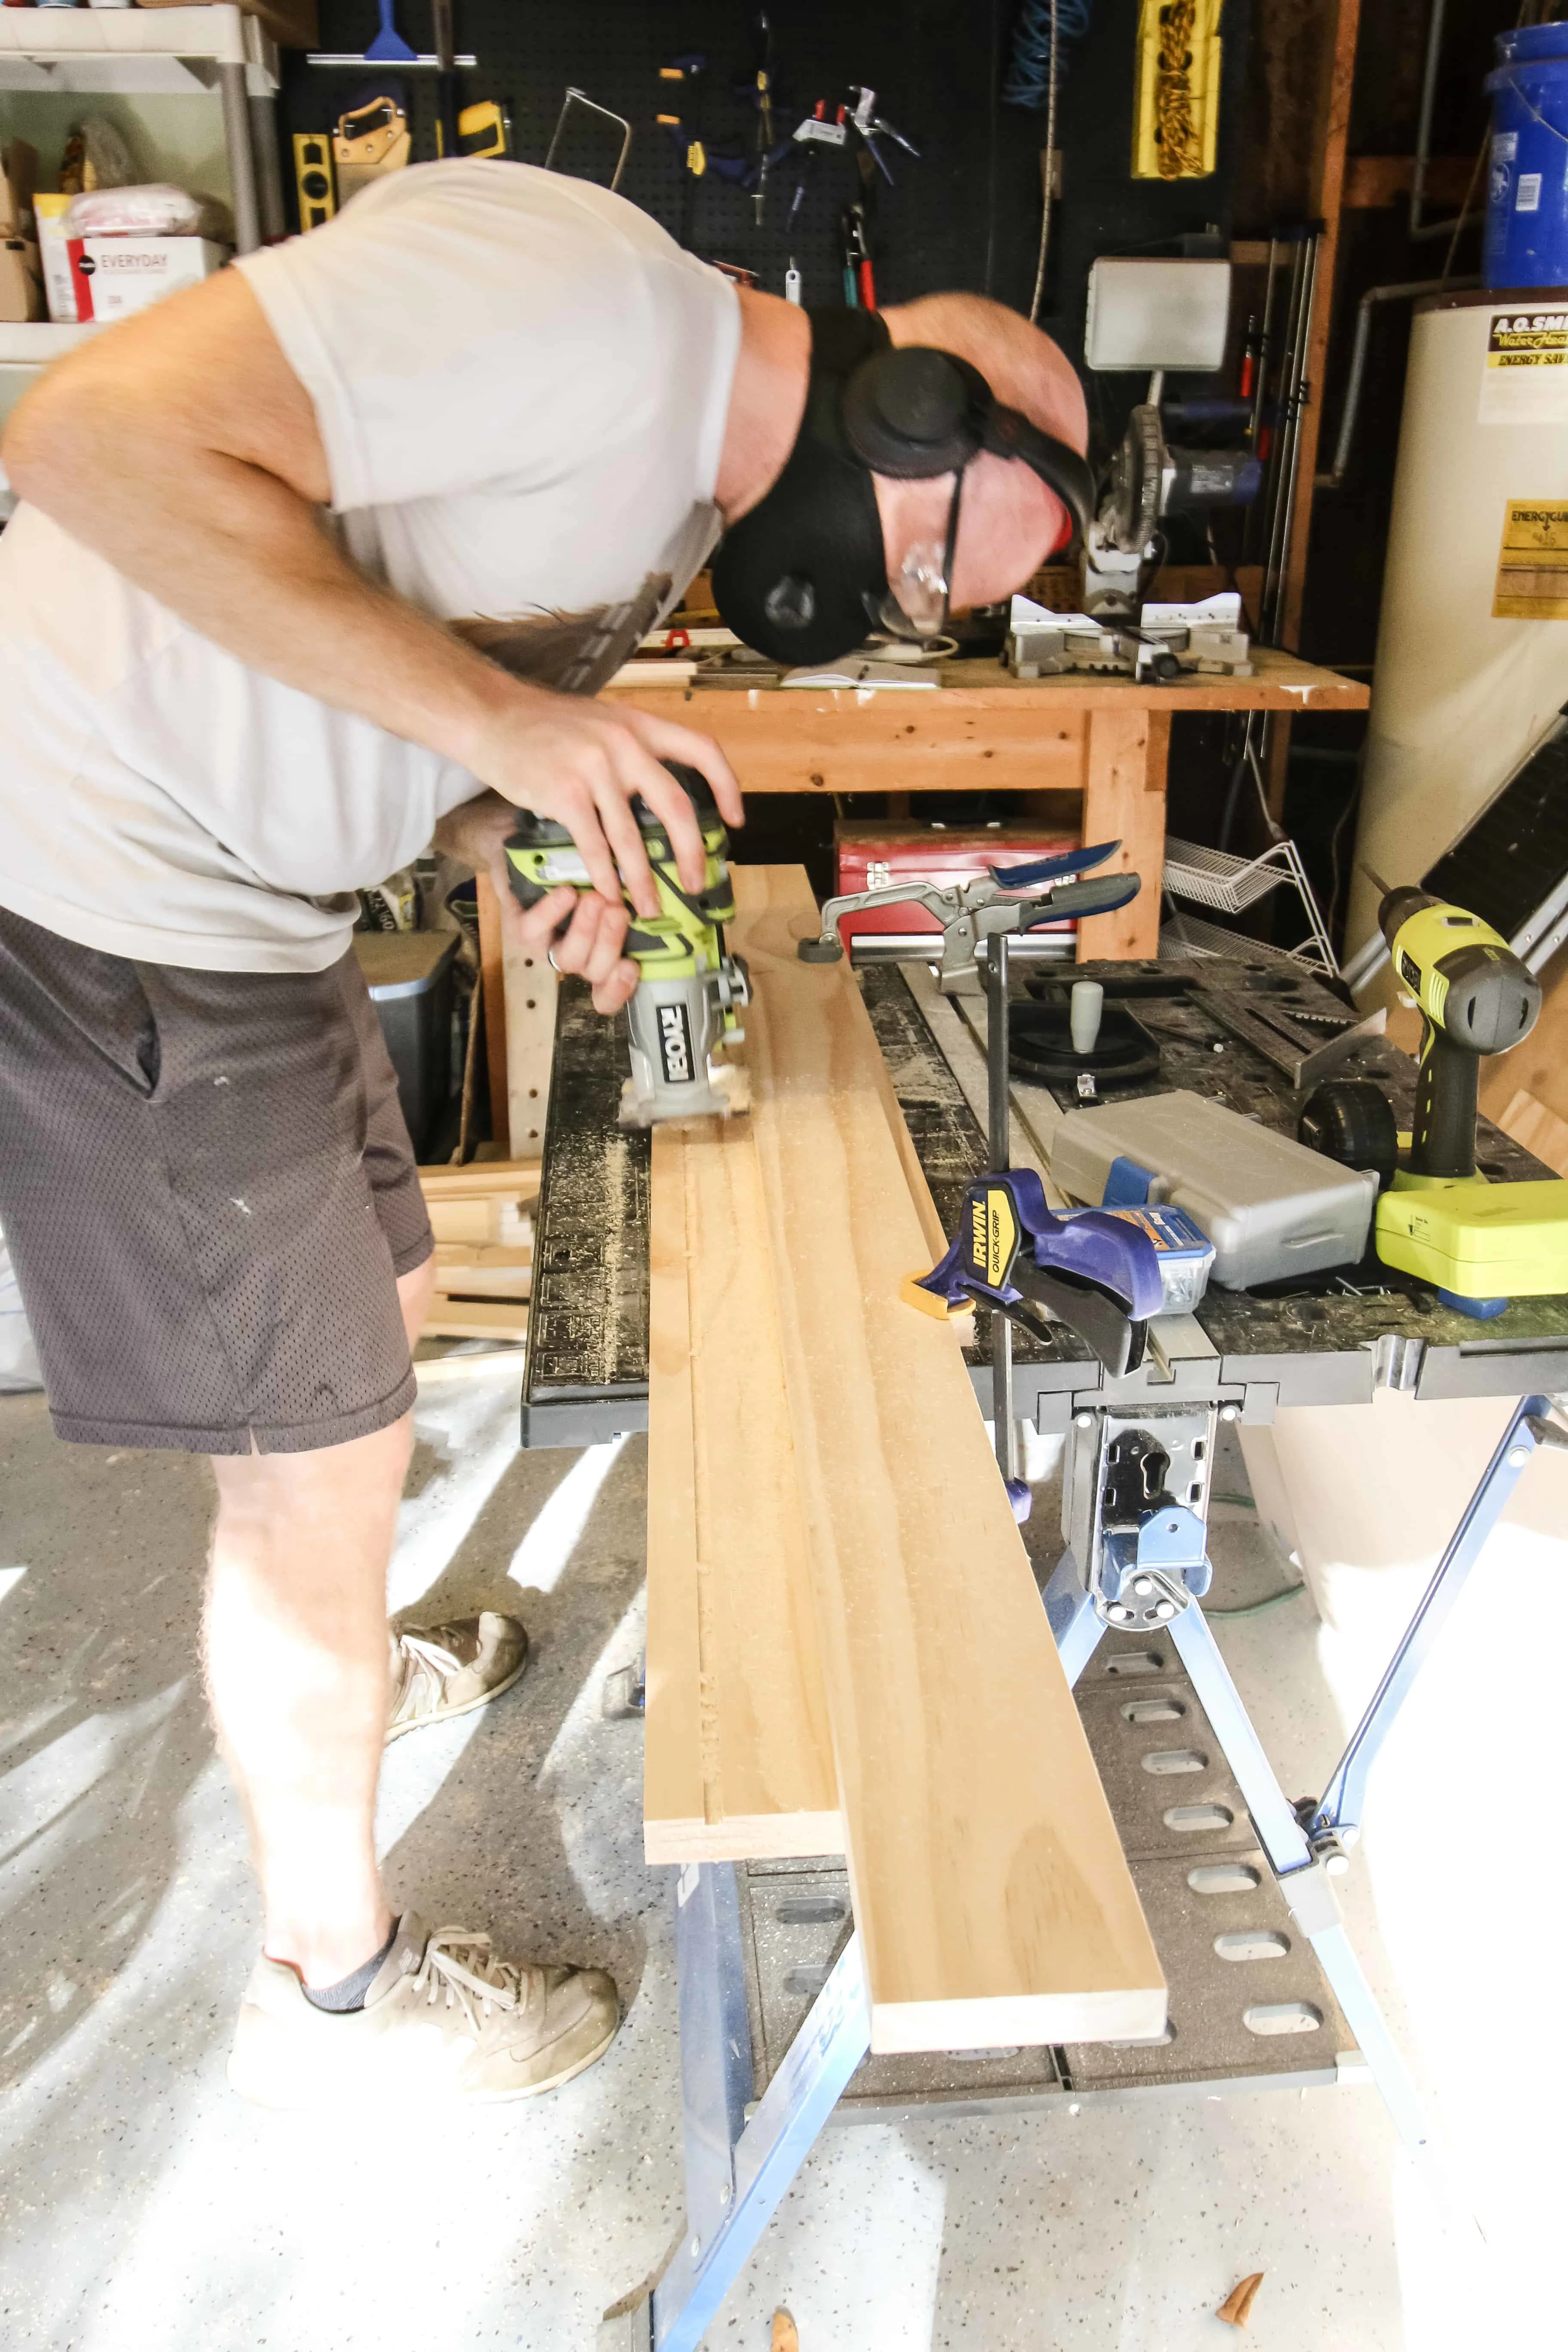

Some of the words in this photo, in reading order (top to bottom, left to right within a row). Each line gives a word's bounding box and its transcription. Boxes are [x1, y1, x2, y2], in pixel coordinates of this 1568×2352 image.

[101, 254, 168, 268] EVERYDAY
[1498, 354, 1541, 365] ENERGY
[660, 1004, 689, 1081] RYOBI
[972, 1200, 986, 1268] IRWIN
